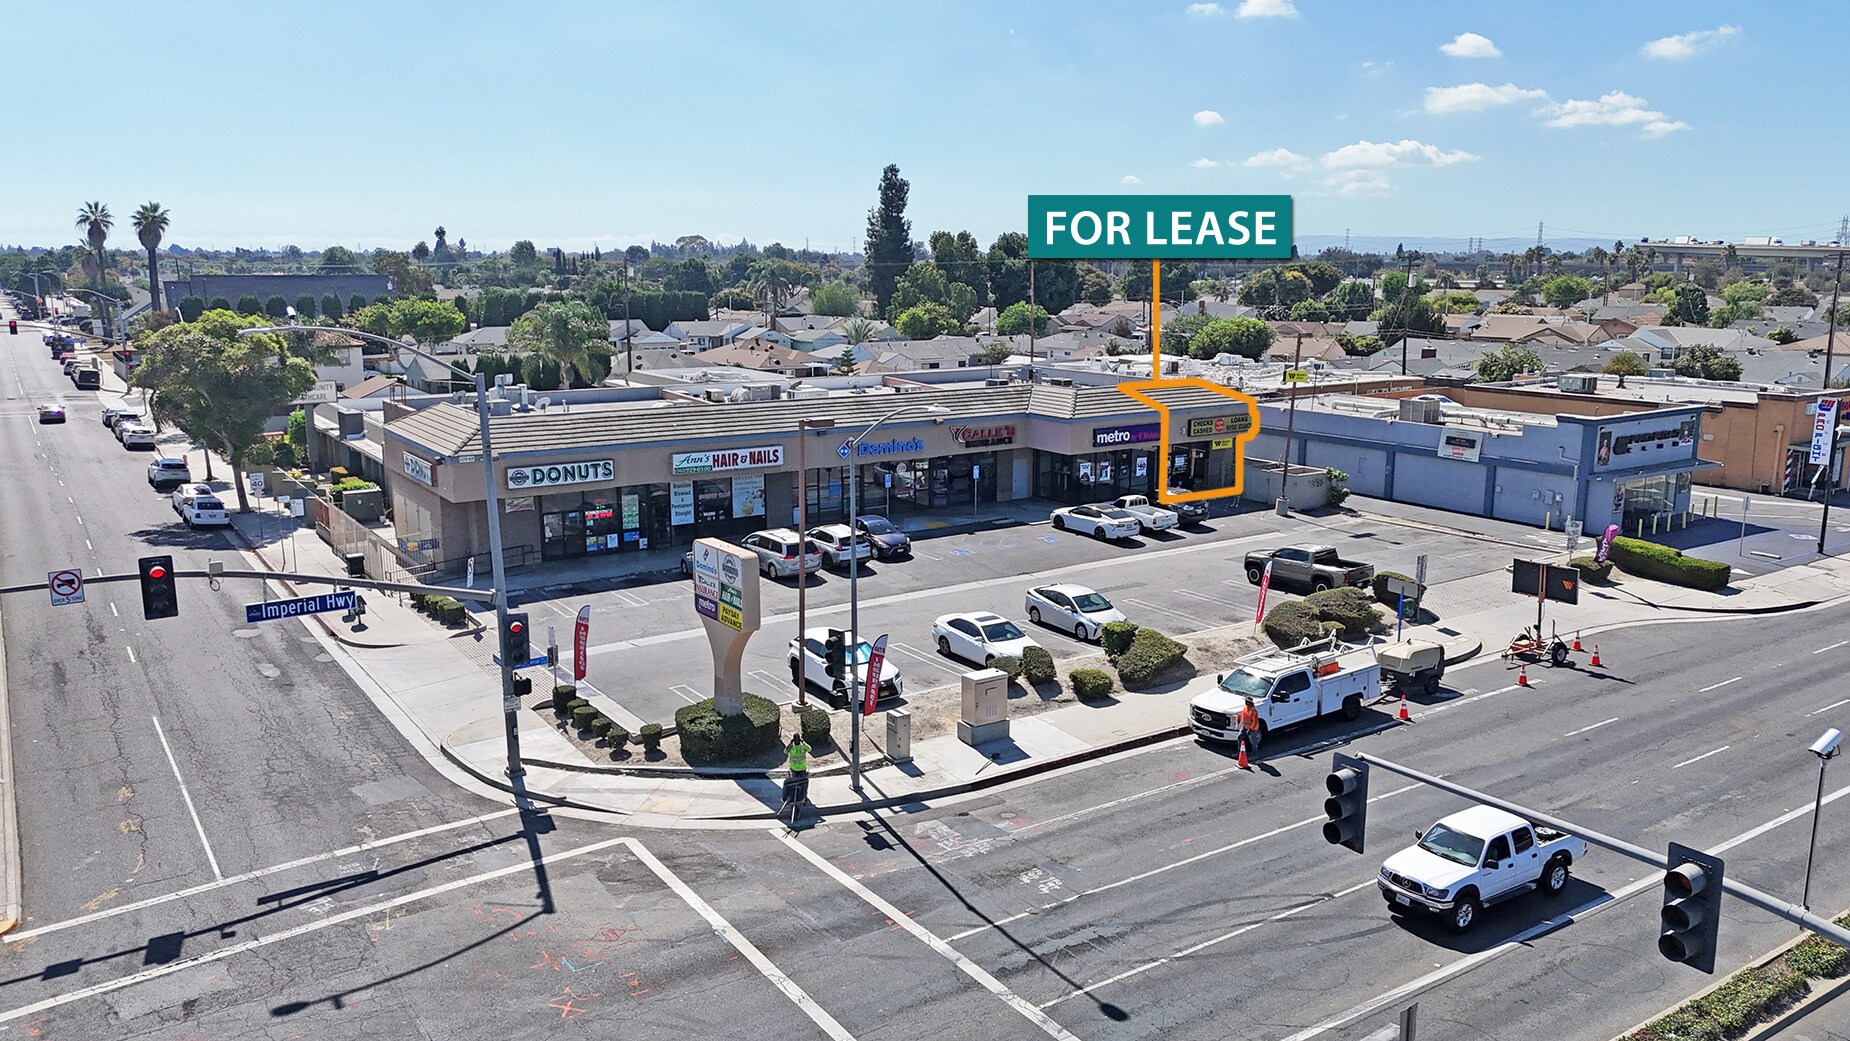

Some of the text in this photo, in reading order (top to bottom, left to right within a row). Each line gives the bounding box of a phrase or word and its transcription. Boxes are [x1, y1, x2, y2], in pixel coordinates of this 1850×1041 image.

[1193, 419, 1213, 428] CHECKS
[1816, 413, 1826, 430] PRO
[1096, 430, 1131, 444] metro
[1193, 427, 1213, 435] CASHED
[859, 437, 925, 457] Domino's
[675, 454, 711, 466] Ann's
[712, 453, 739, 468] HAIR
[749, 449, 780, 465] NAILS
[530, 461, 613, 485] DONUTS
[696, 560, 717, 575] Domino's
[261, 594, 354, 618] Imperial Hwy
[698, 598, 715, 612] metro
[722, 606, 740, 620] PAYDAY
[721, 614, 743, 631] ADVANCE
